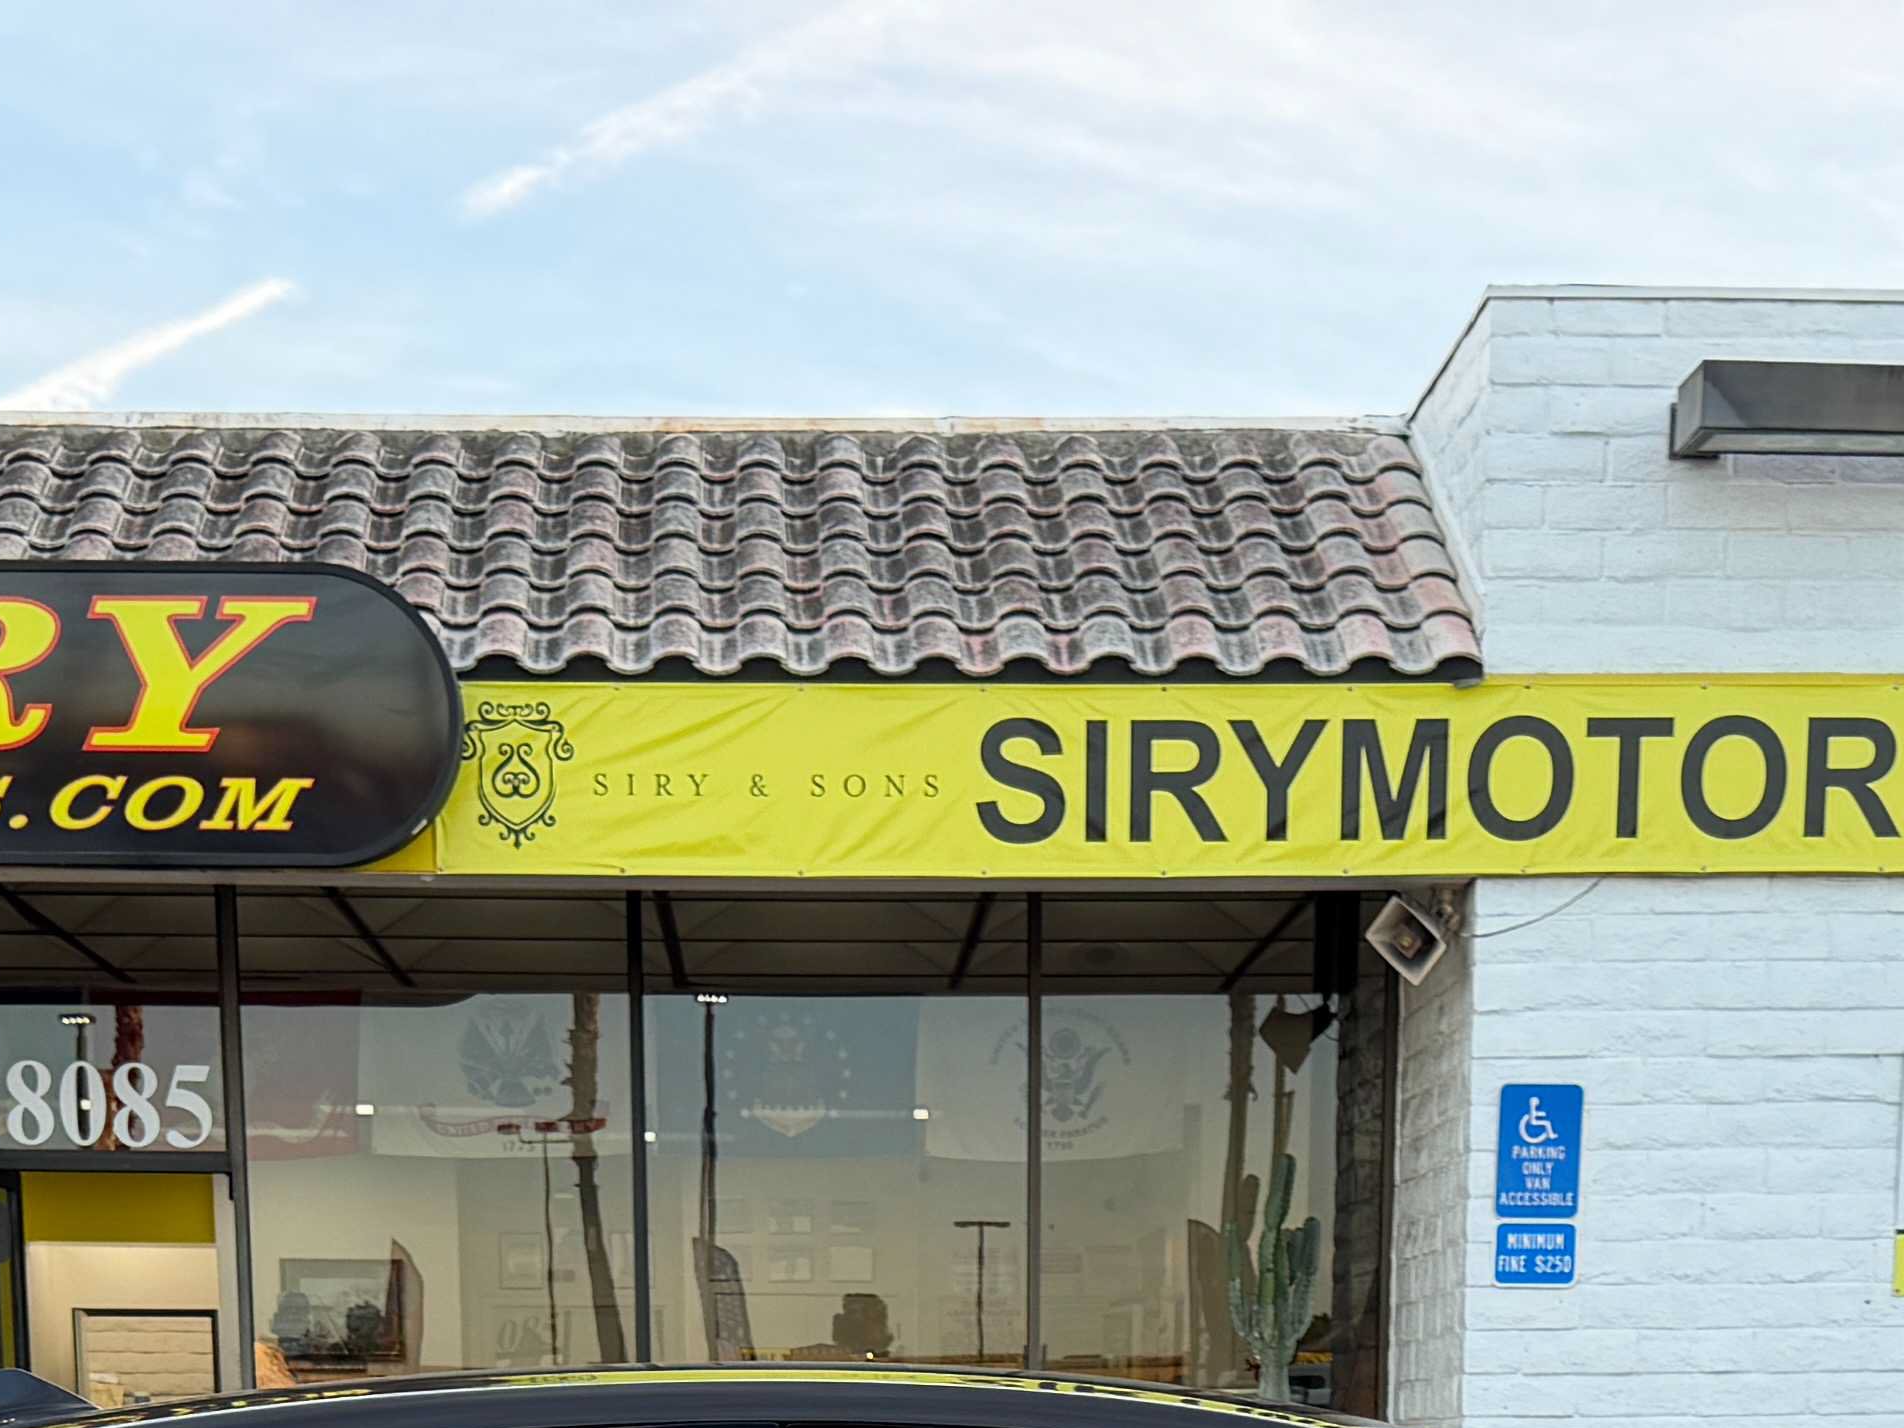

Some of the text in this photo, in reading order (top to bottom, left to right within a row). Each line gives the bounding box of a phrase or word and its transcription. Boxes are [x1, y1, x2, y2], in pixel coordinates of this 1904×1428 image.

[592, 773, 940, 798] SIRY & SONS
[4, 1058, 214, 1150] 8085
[1512, 1145, 1566, 1160] PARKING
[1521, 1161, 1554, 1176] ONLY
[1524, 1177, 1551, 1190] VAN
[1499, 1192, 1575, 1207] ACCESSIBLE
[1507, 1233, 1565, 1250] MINIMUM
[1498, 1255, 1572, 1273] FINE $250
